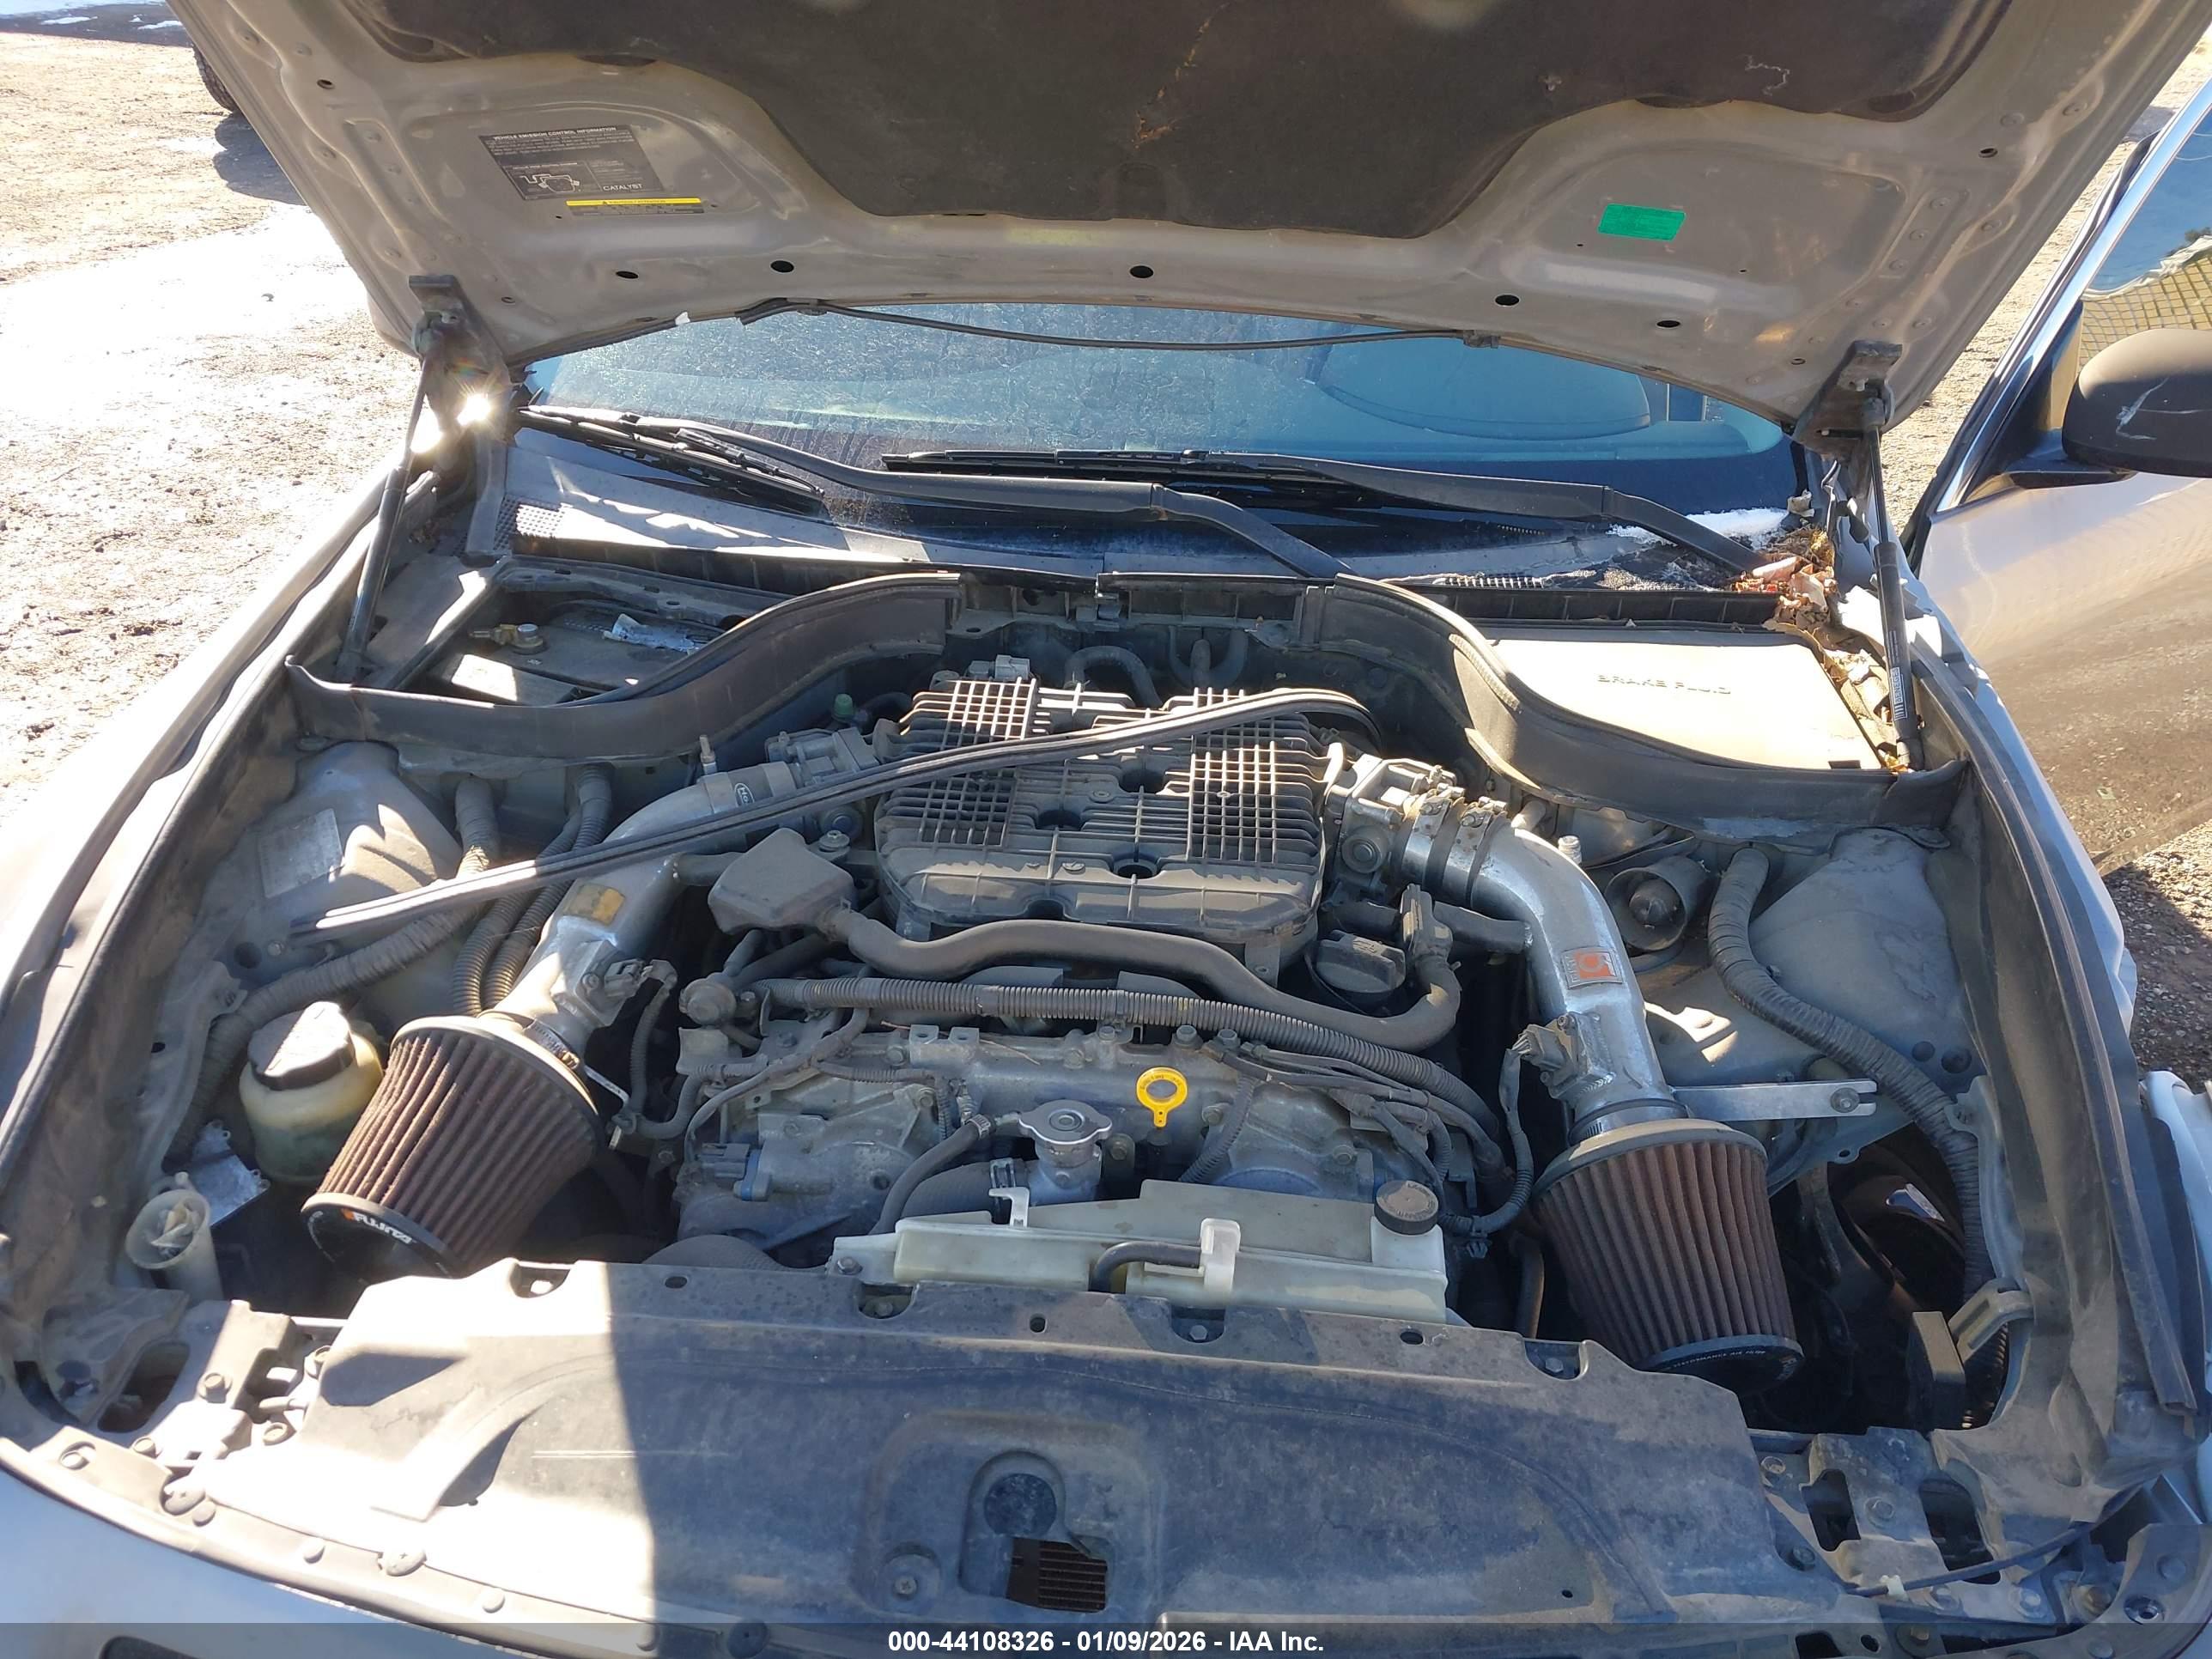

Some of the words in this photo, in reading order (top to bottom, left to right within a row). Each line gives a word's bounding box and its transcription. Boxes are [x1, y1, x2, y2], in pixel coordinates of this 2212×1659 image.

[603, 183, 643, 191] CATALYST
[1597, 675, 1668, 688] BRAKE
[352, 1212, 413, 1244] FUJITA
